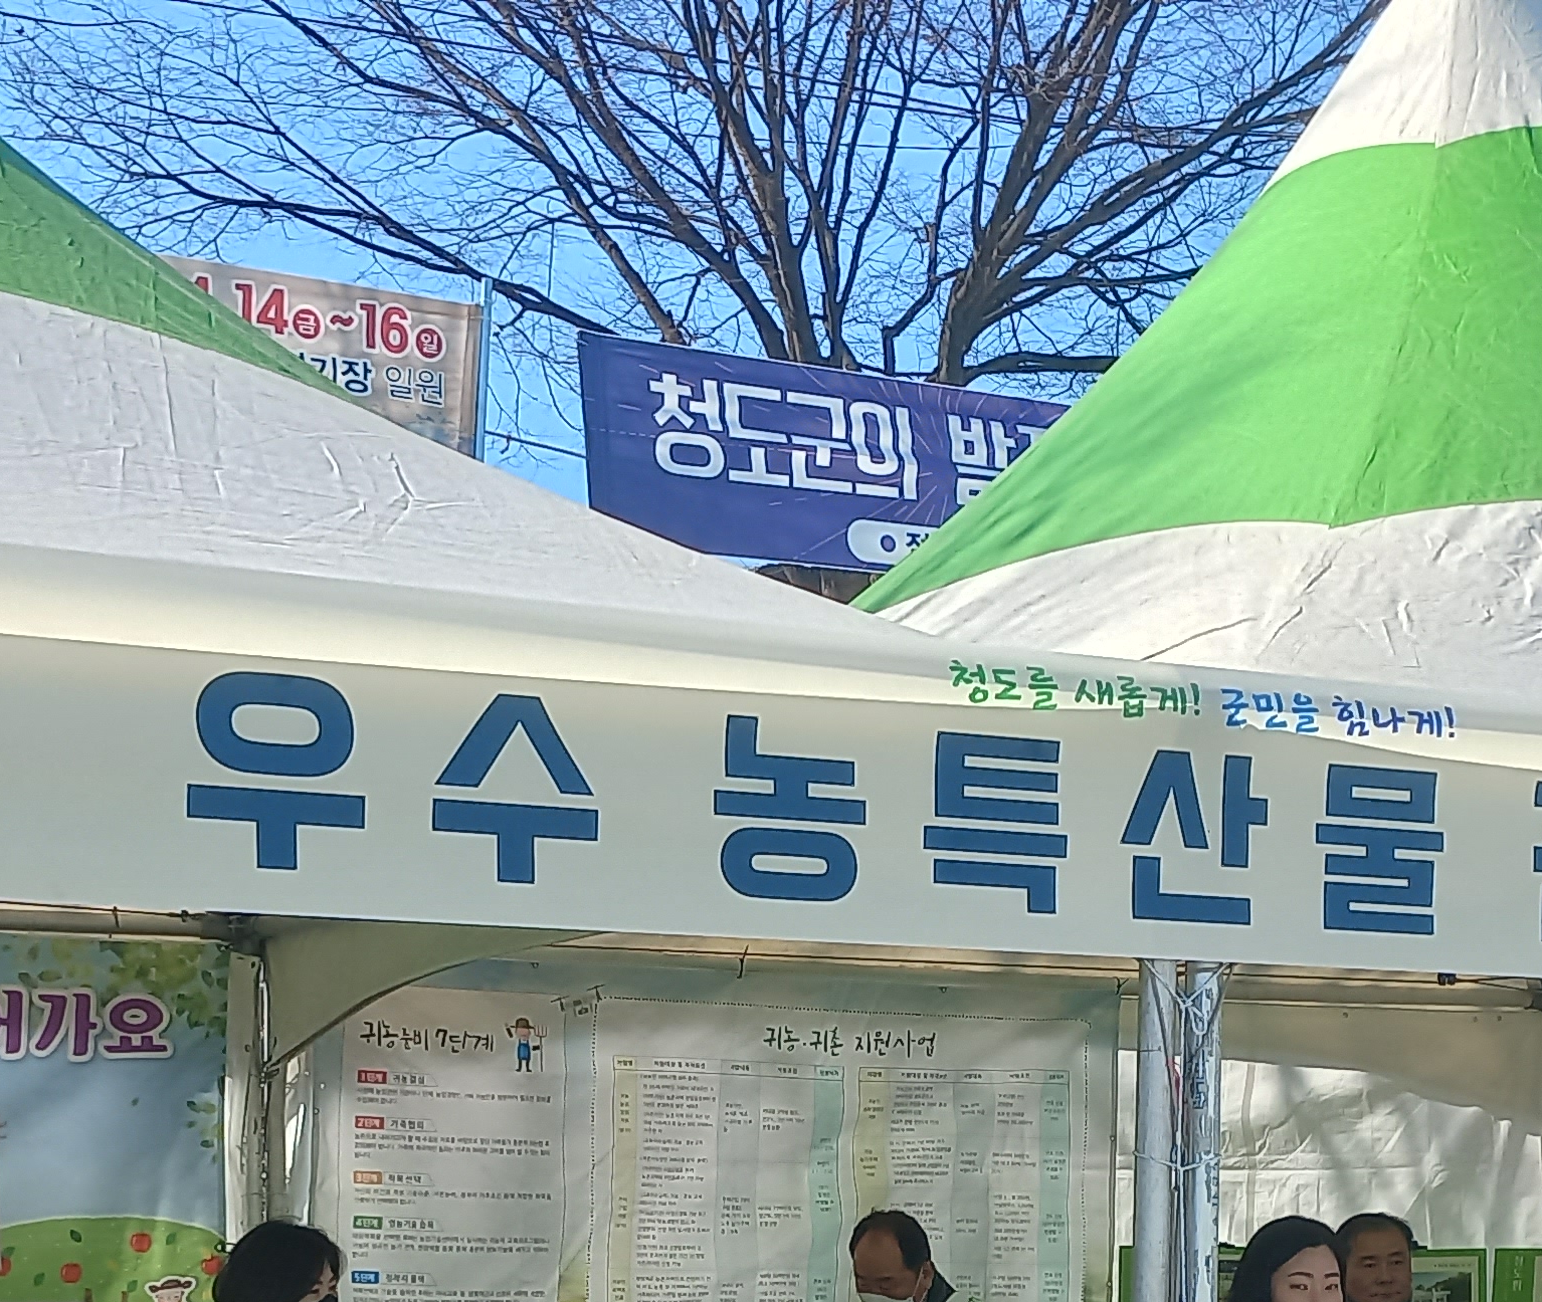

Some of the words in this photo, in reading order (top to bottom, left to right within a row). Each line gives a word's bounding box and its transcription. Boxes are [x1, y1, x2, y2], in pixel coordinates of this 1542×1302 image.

[385, 366, 444, 406] 일원
[648, 373, 920, 501] 청도군의
[947, 413, 1051, 506] 발
[949, 659, 1060, 712] 청도를
[1074, 676, 1202, 718] 새롭게!
[1221, 686, 1321, 736] 군민을
[1332, 694, 1457, 739] 힘나게!
[186, 671, 599, 885] 우수
[714, 714, 1445, 936] 농특산물
[435, 1027, 495, 1054] 7단계
[763, 1025, 845, 1057] 귀농·귀촌
[855, 1030, 937, 1059] 지원사업
